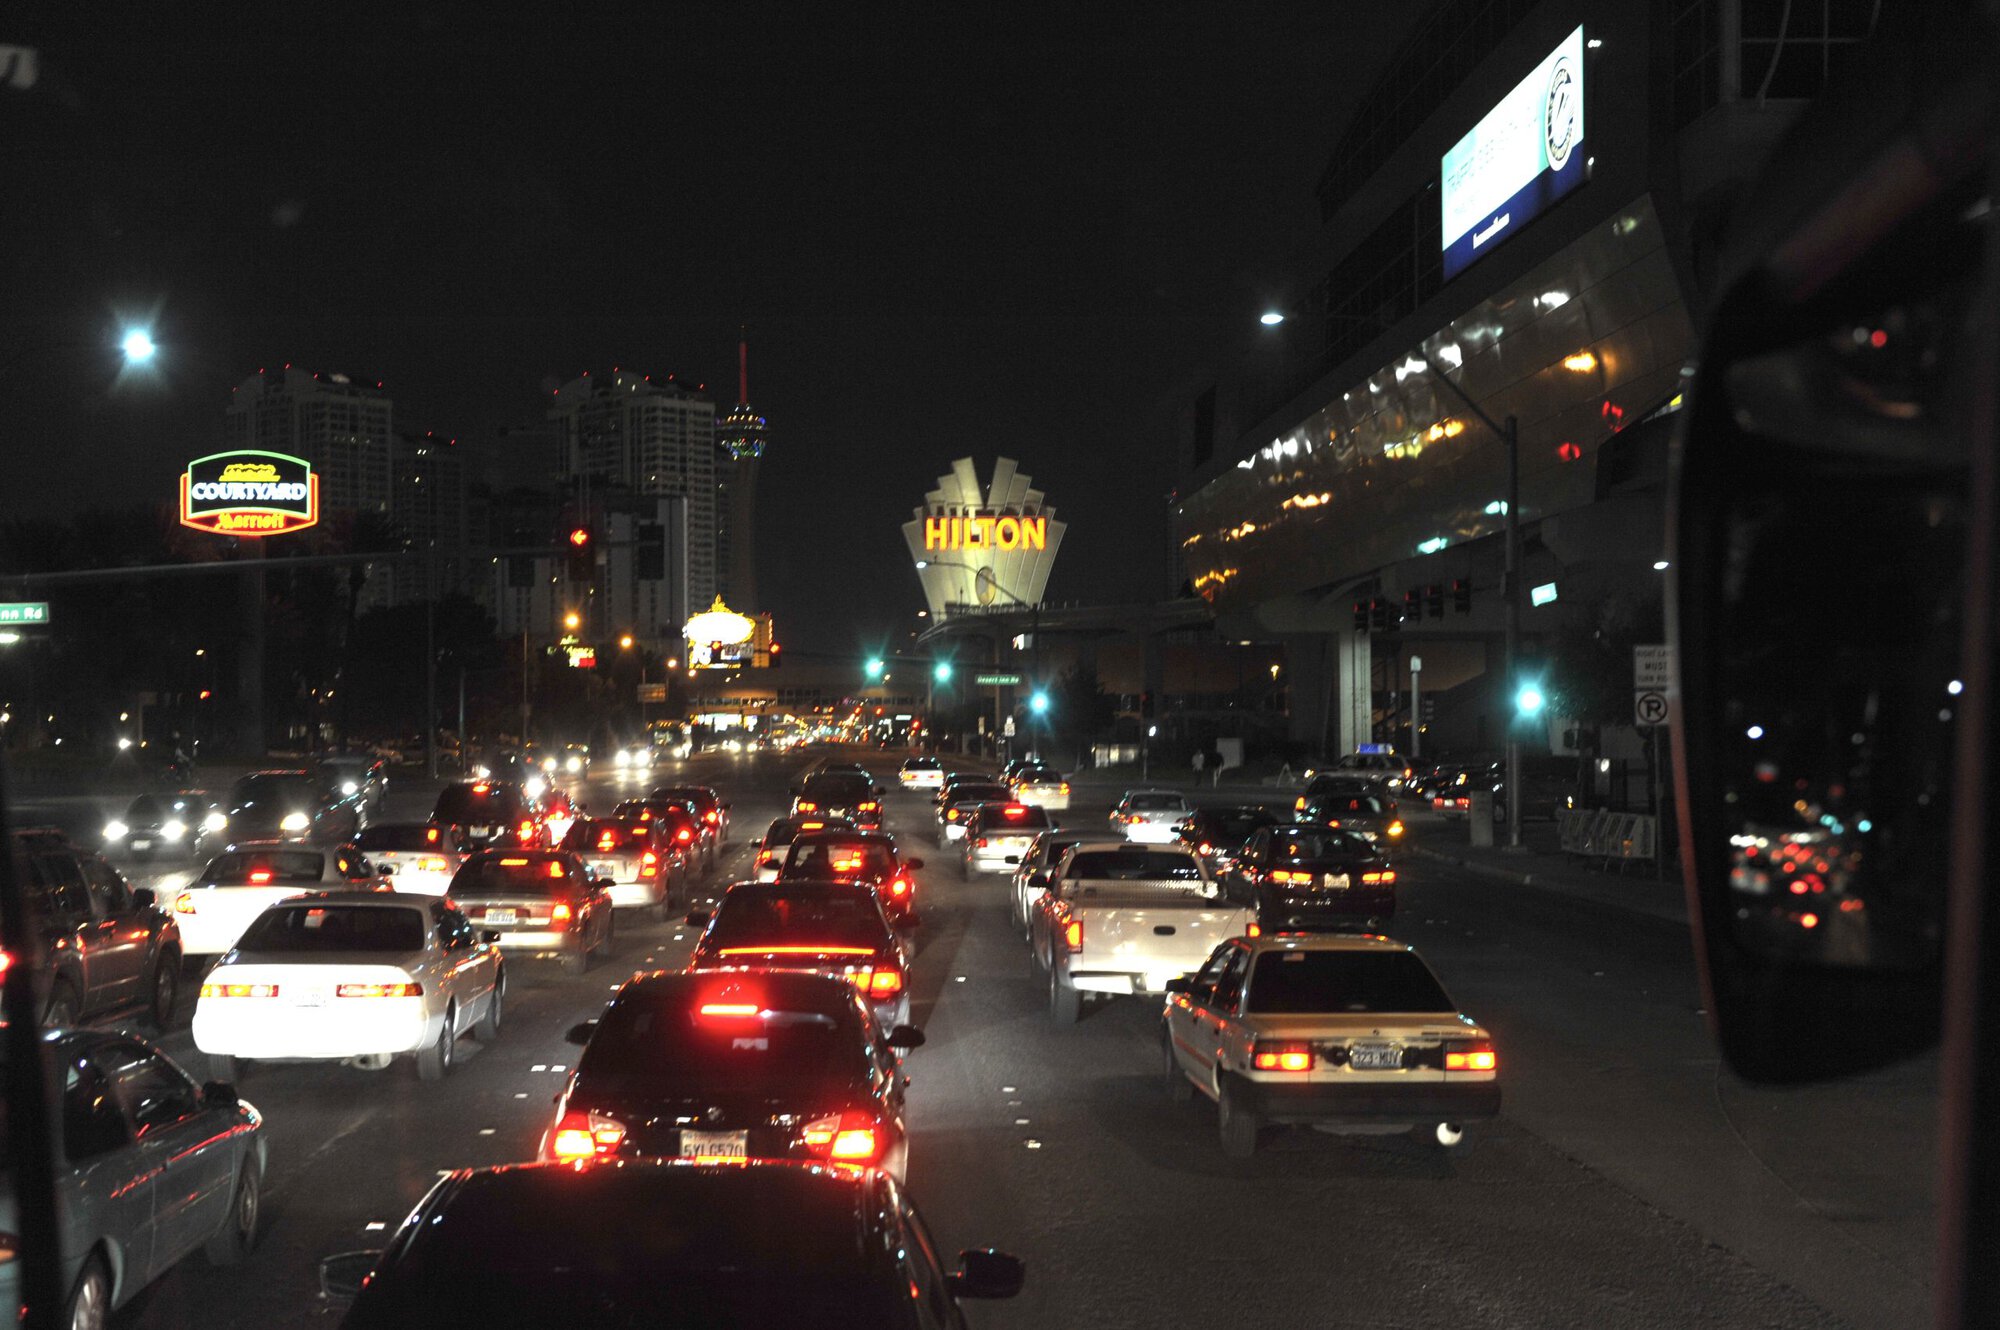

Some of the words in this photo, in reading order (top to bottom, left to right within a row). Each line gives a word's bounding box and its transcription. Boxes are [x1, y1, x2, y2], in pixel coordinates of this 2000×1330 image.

[191, 482, 307, 500] COURTYARD
[926, 516, 1046, 550] HILTON
[1, 609, 20, 620] nn
[24, 606, 43, 620] Rd
[1644, 662, 1668, 671] MUST
